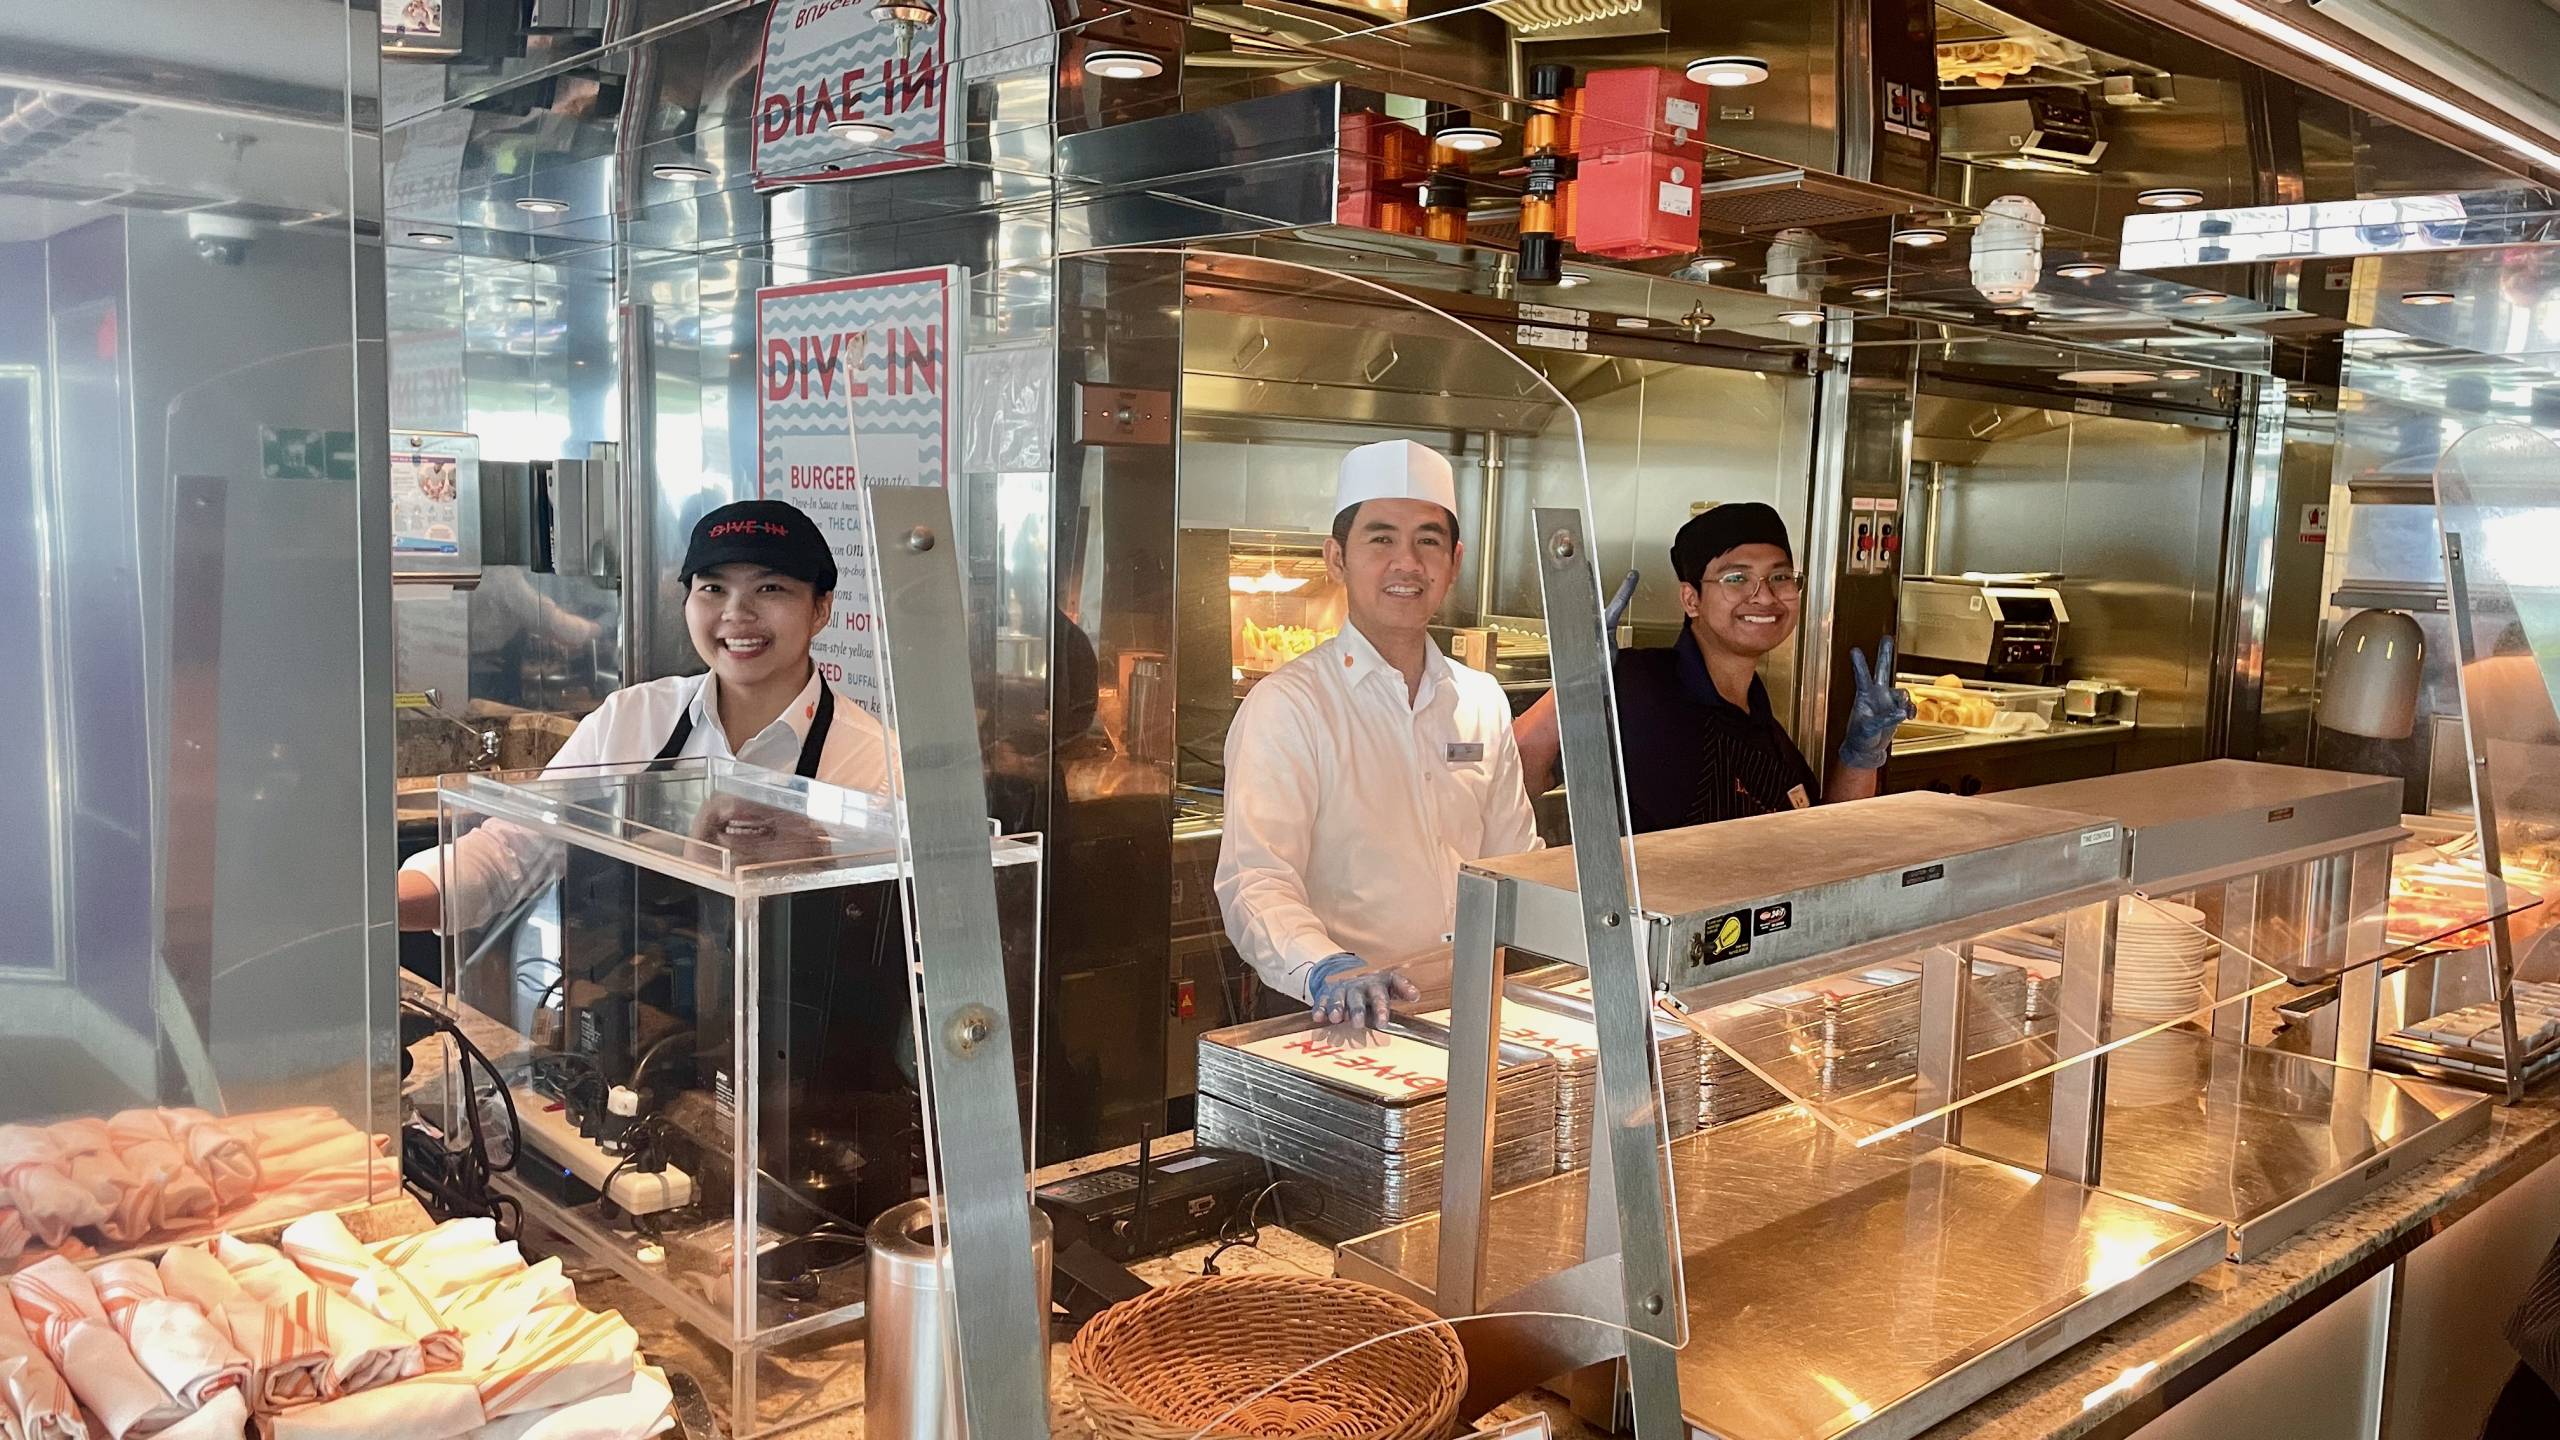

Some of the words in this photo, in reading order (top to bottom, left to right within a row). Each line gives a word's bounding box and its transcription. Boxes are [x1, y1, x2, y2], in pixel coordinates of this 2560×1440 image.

[887, 324, 936, 396] IN
[791, 465, 856, 491] BURGER
[818, 496, 838, 511] Sauce
[709, 519, 757, 538] DIVE
[763, 521, 787, 538] IN
[829, 517, 845, 531] THE
[845, 611, 871, 633] HOT
[847, 672, 877, 689] BUFFAL
